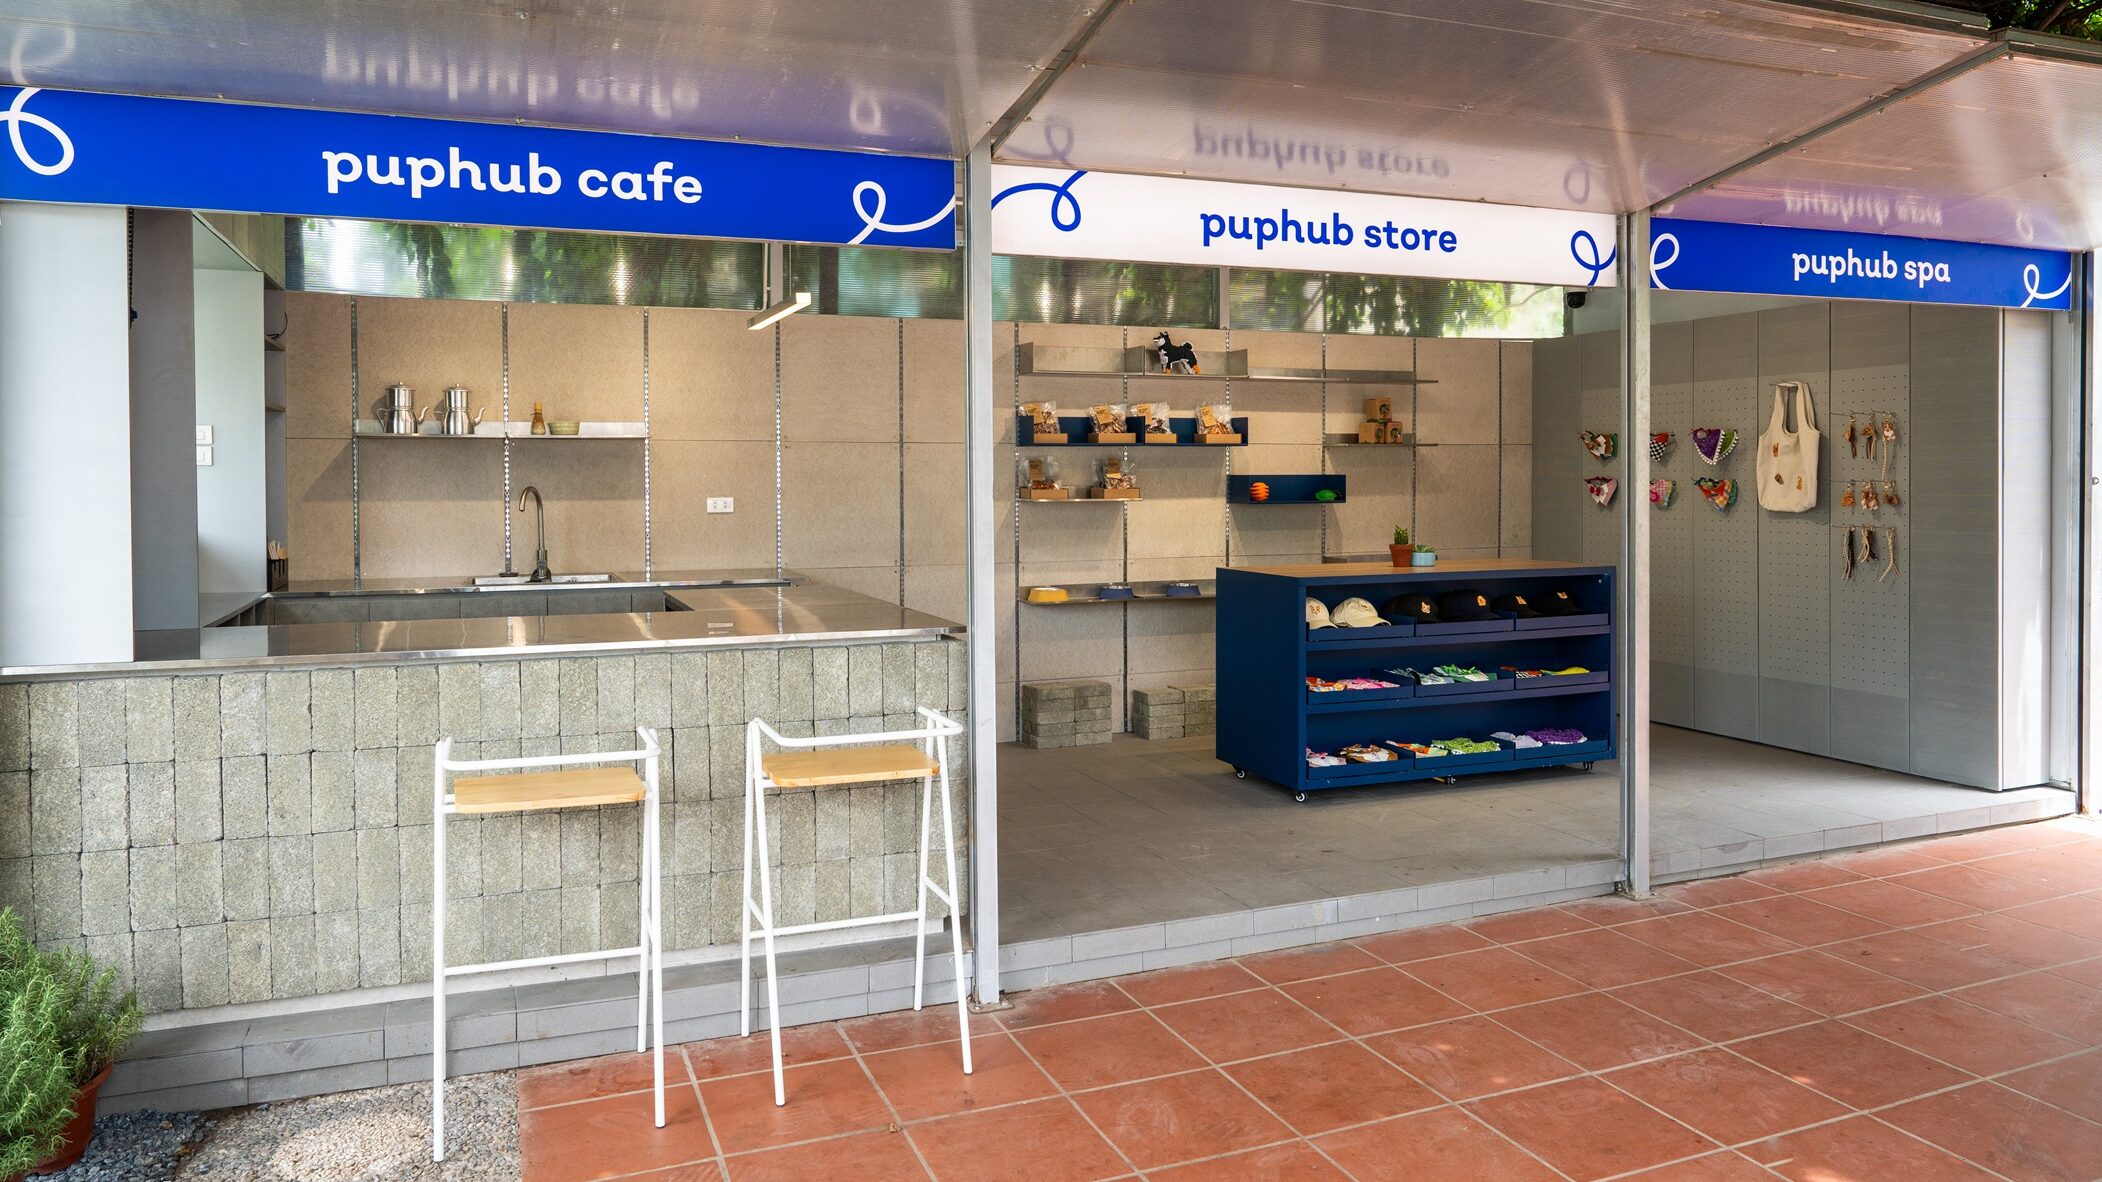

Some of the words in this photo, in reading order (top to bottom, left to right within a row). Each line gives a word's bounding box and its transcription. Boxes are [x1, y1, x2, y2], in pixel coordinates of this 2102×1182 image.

[321, 147, 562, 198] puphub
[578, 160, 703, 205] cafe
[1200, 208, 1354, 250] puphub
[1363, 221, 1458, 253] store
[1791, 247, 1898, 283] puphub
[1903, 260, 1951, 289] spa
